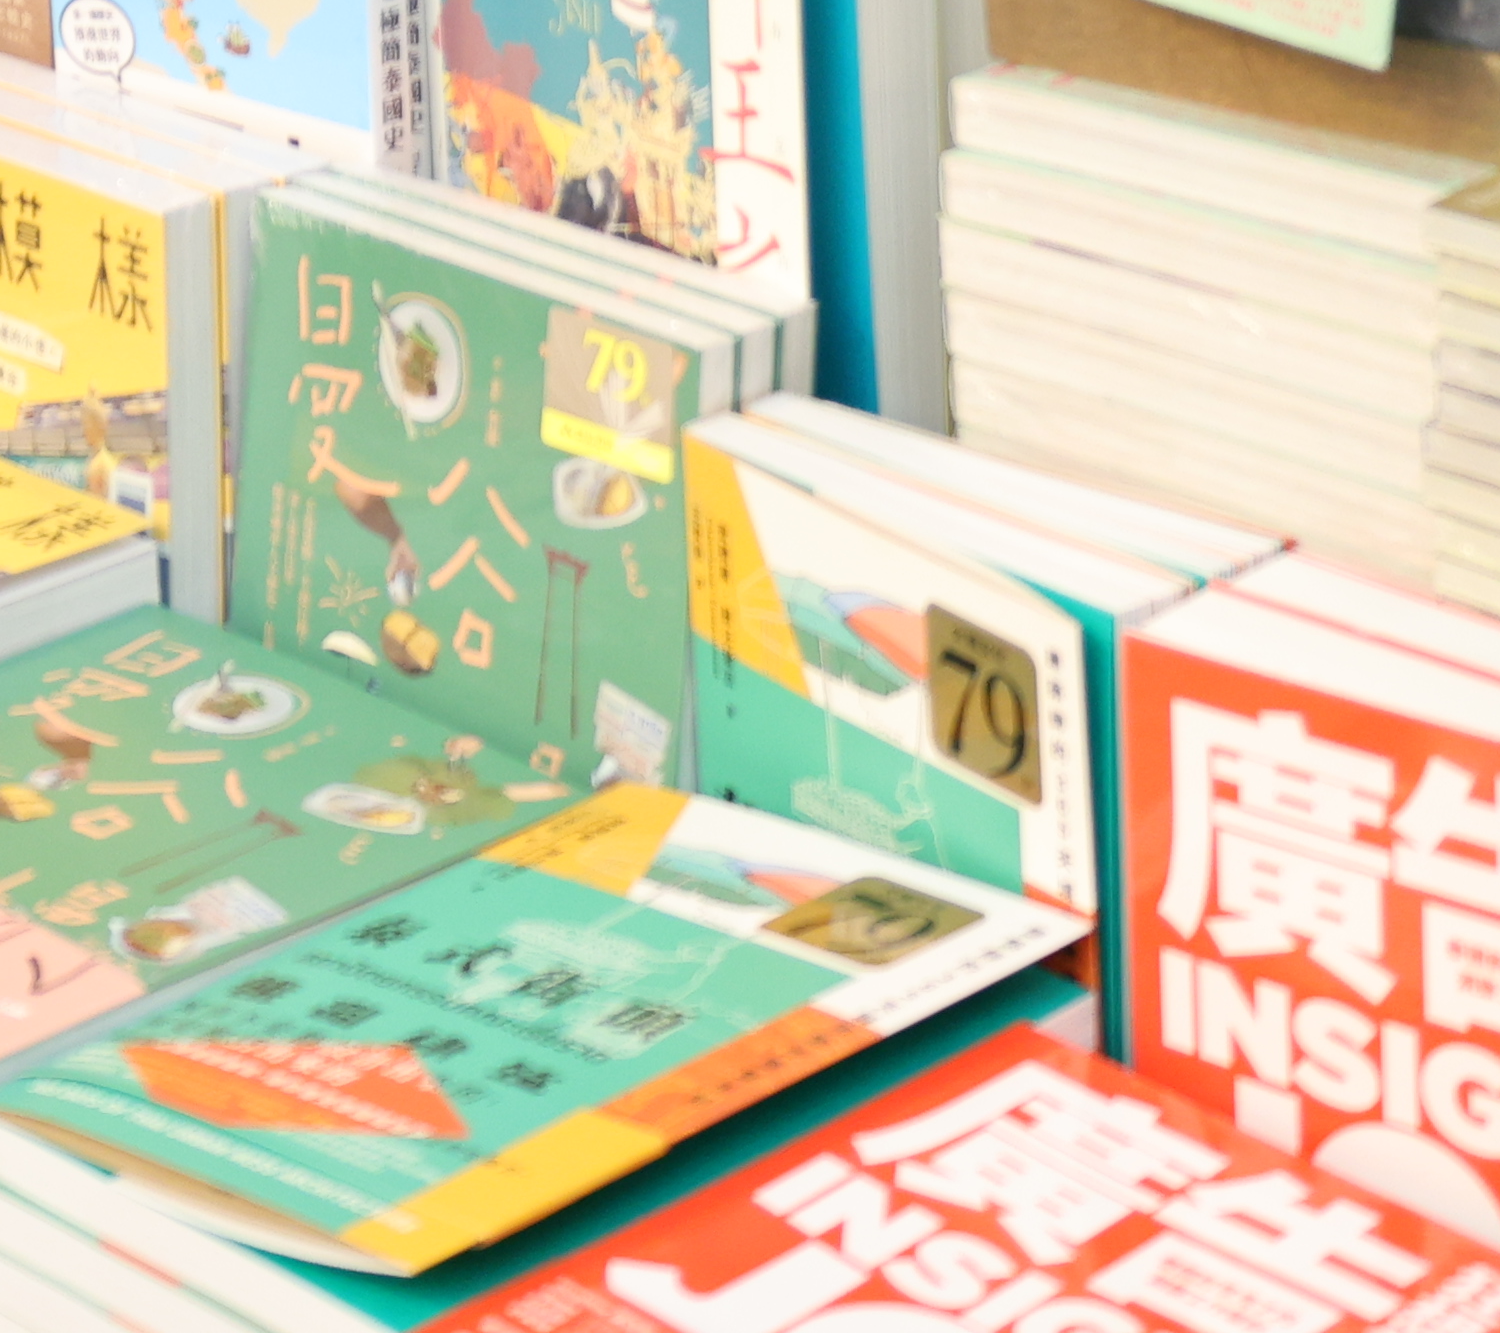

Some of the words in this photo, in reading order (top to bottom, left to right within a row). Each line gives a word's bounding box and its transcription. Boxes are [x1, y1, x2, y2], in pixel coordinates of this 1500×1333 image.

[377, 7, 407, 156] 極簡泰國史
[581, 328, 648, 402] 79
[936, 647, 1028, 785] 79
